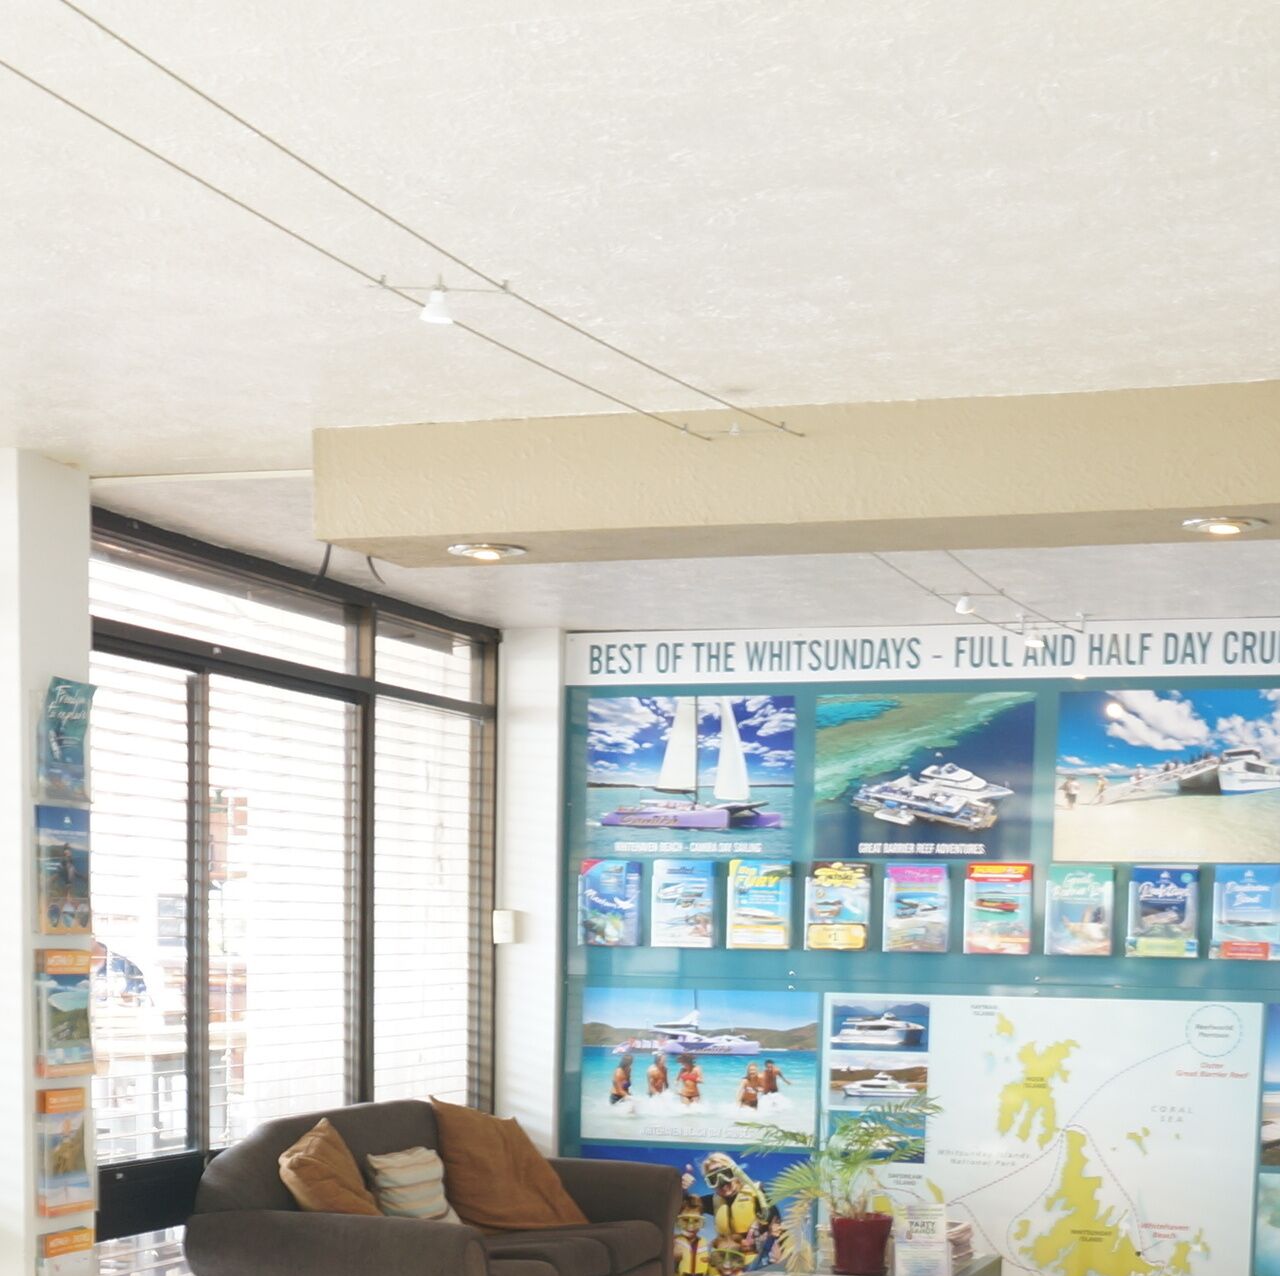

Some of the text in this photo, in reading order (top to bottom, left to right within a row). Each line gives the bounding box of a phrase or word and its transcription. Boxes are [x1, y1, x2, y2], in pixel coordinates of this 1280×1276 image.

[588, 643, 647, 675] BEST
[655, 642, 684, 674] OF
[691, 641, 735, 673] THE
[745, 637, 921, 671] WHITSUNDAYS
[954, 635, 1013, 668] FULL
[1022, 633, 1076, 667] AND
[1088, 632, 1153, 666] HALF
[1162, 631, 1213, 666] DAY
[1150, 1105, 1193, 1114] CORAL
